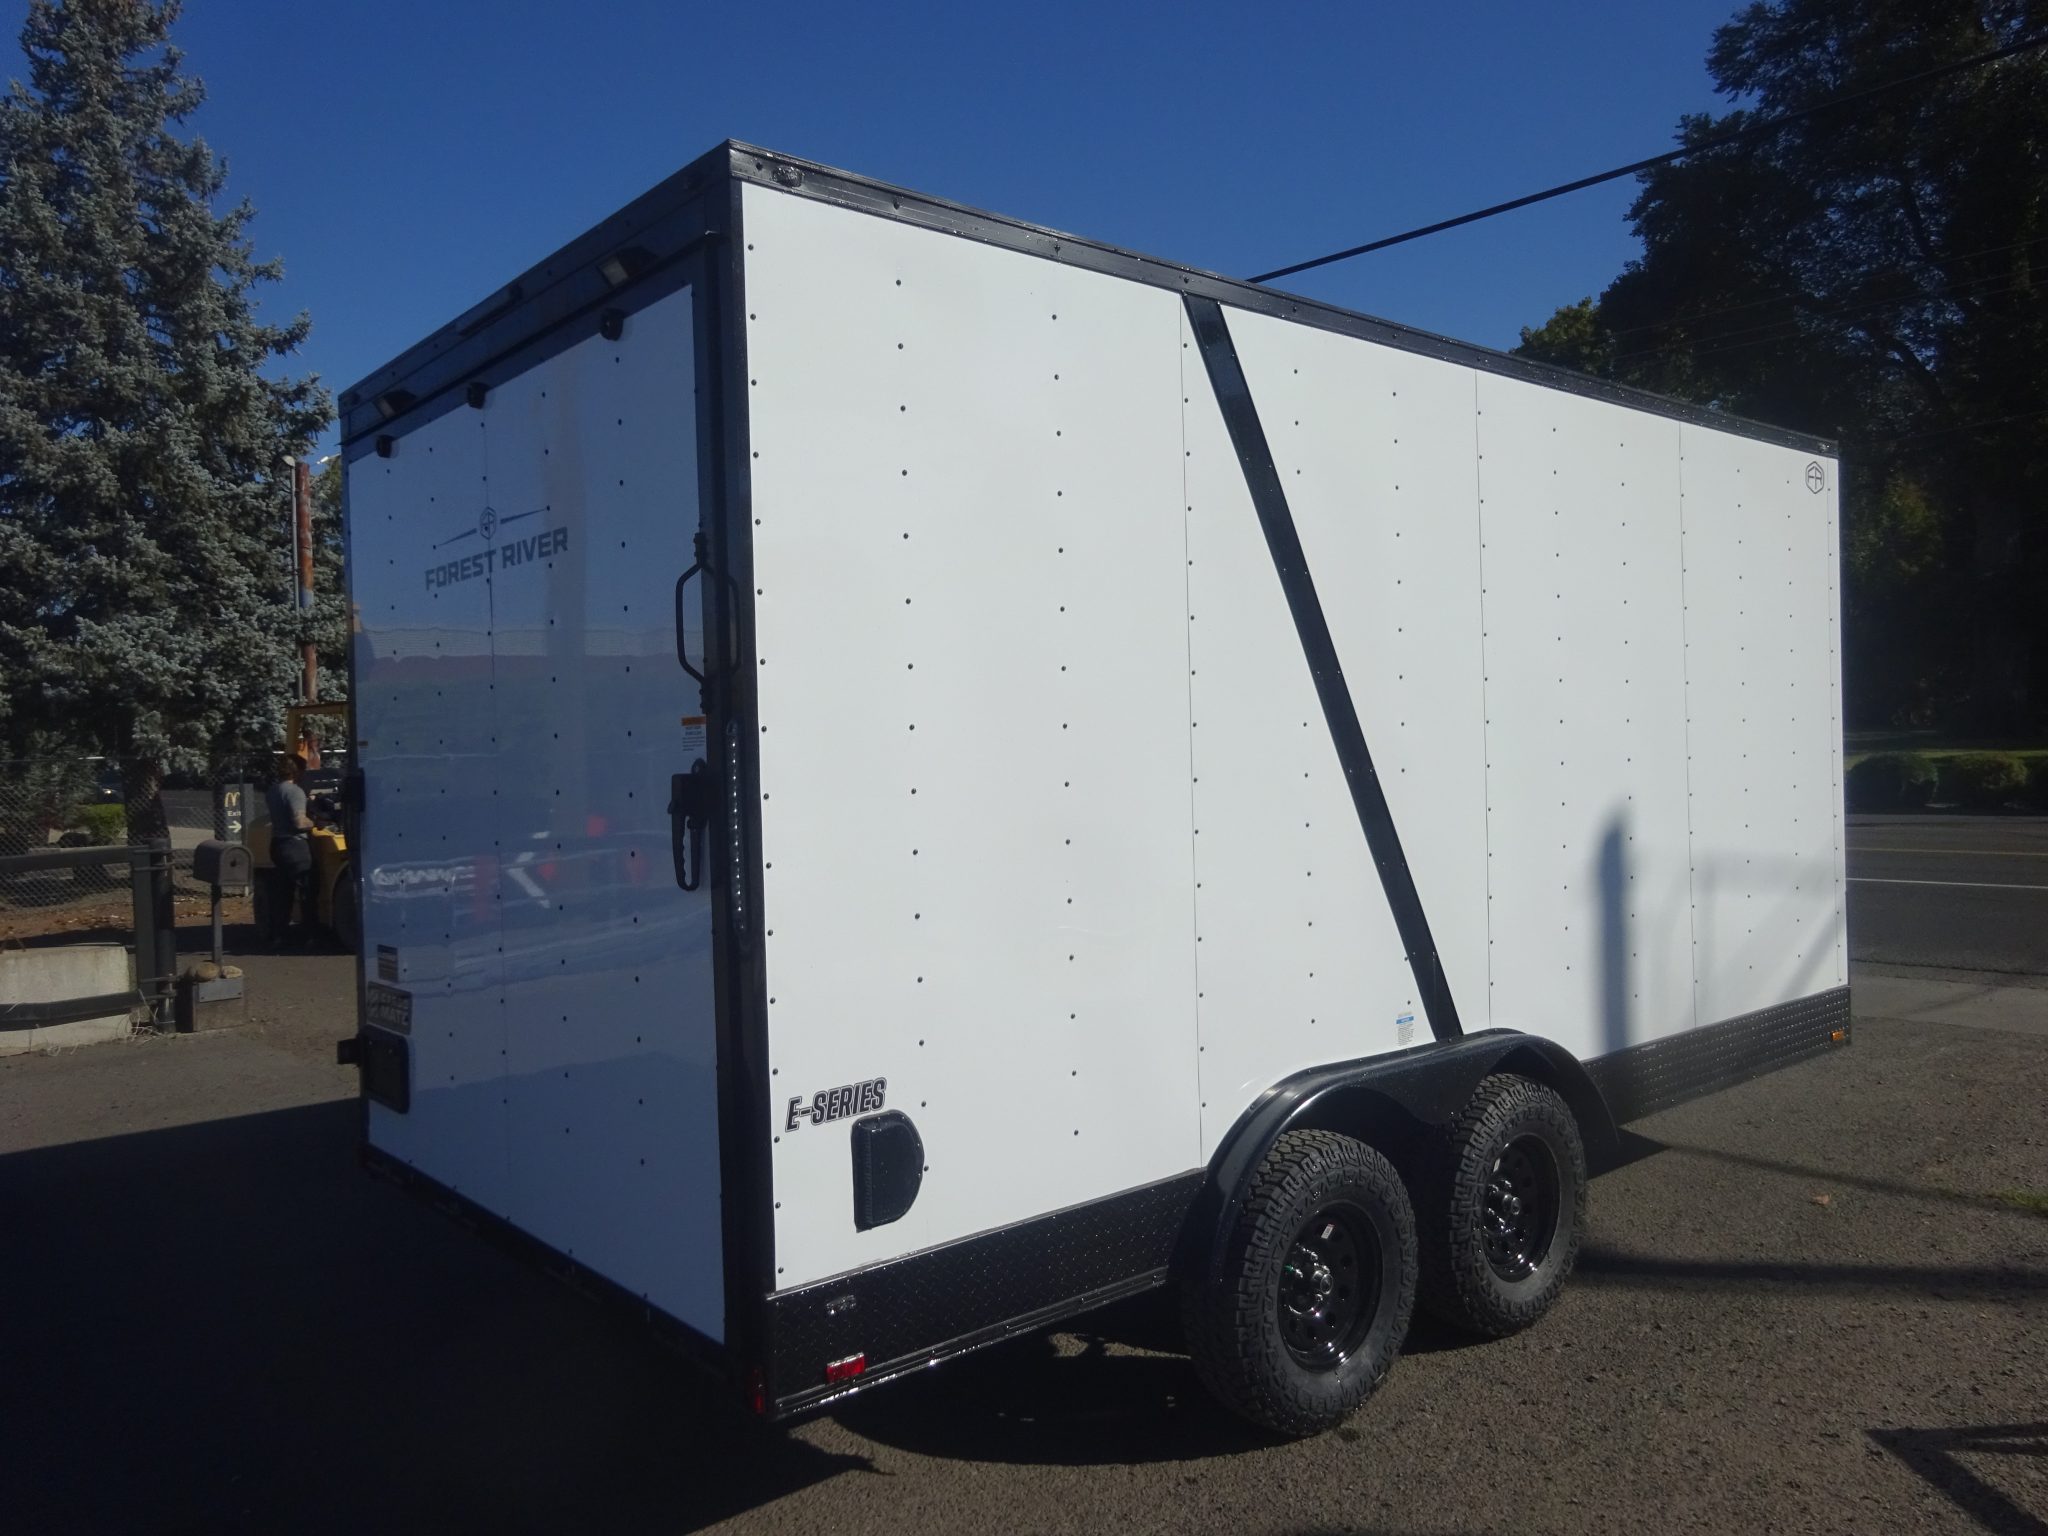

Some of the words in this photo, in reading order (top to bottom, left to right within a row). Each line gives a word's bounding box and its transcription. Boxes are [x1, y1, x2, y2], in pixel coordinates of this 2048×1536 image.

[425, 550, 496, 591] FOREST
[501, 526, 568, 569] RIVER
[785, 1077, 887, 1132] E-SERIES
